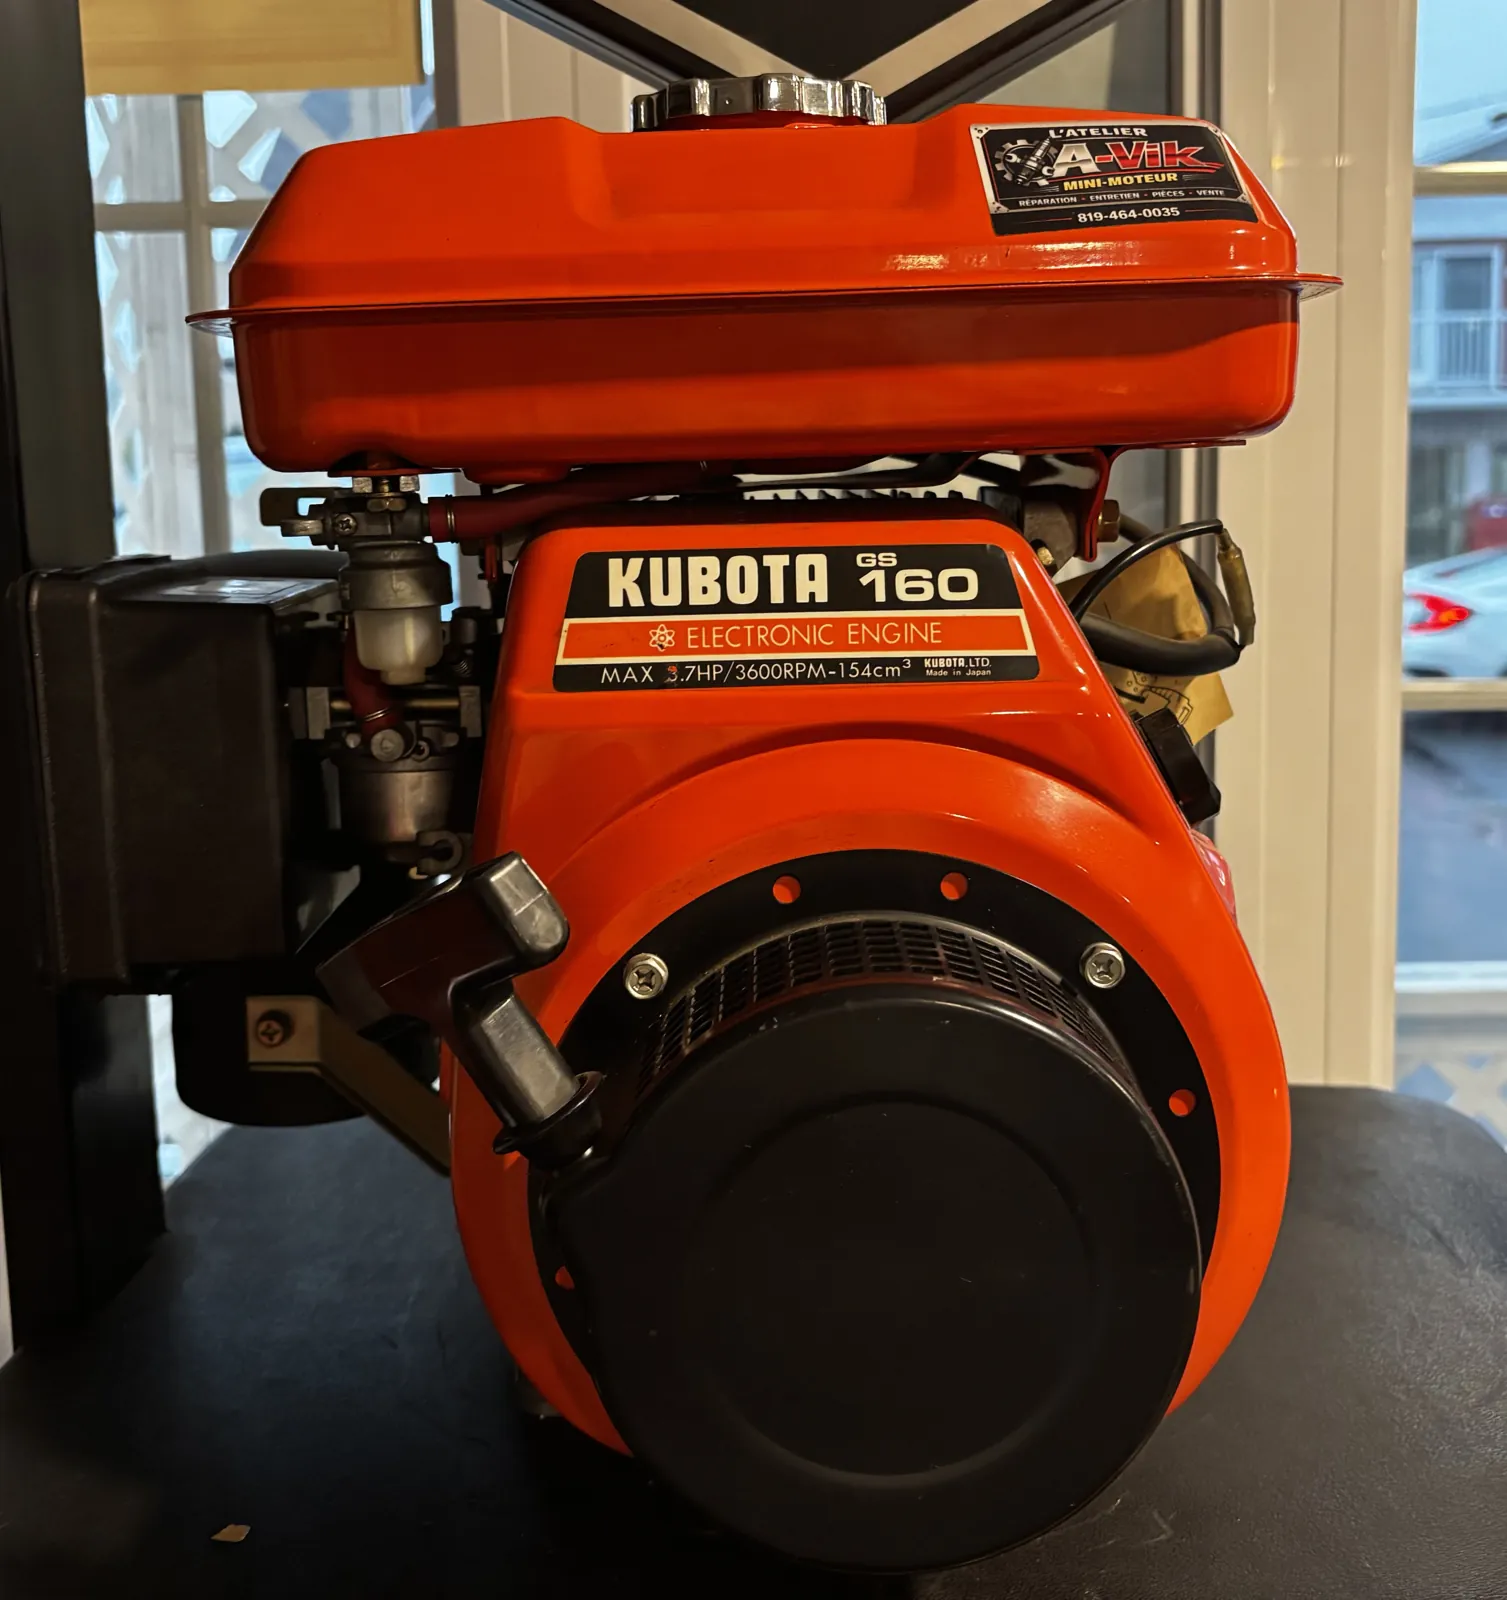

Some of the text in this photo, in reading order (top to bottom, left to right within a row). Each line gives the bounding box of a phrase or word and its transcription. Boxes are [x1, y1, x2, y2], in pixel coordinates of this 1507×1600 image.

[1049, 127, 1148, 139] L'ATELIER
[1063, 173, 1178, 191] MINI-MOTEUR
[1018, 188, 1225, 207] RÉPARATION ENTRETIEN PIÈCES VENTE
[1077, 207, 1180, 223] 819-464-0035
[856, 553, 898, 568] GS
[608, 554, 979, 607] KUBOTA 160
[687, 622, 943, 649] ELECTRONIC ENGINE
[601, 666, 654, 684] MAX
[966, 668, 992, 678] Japan
